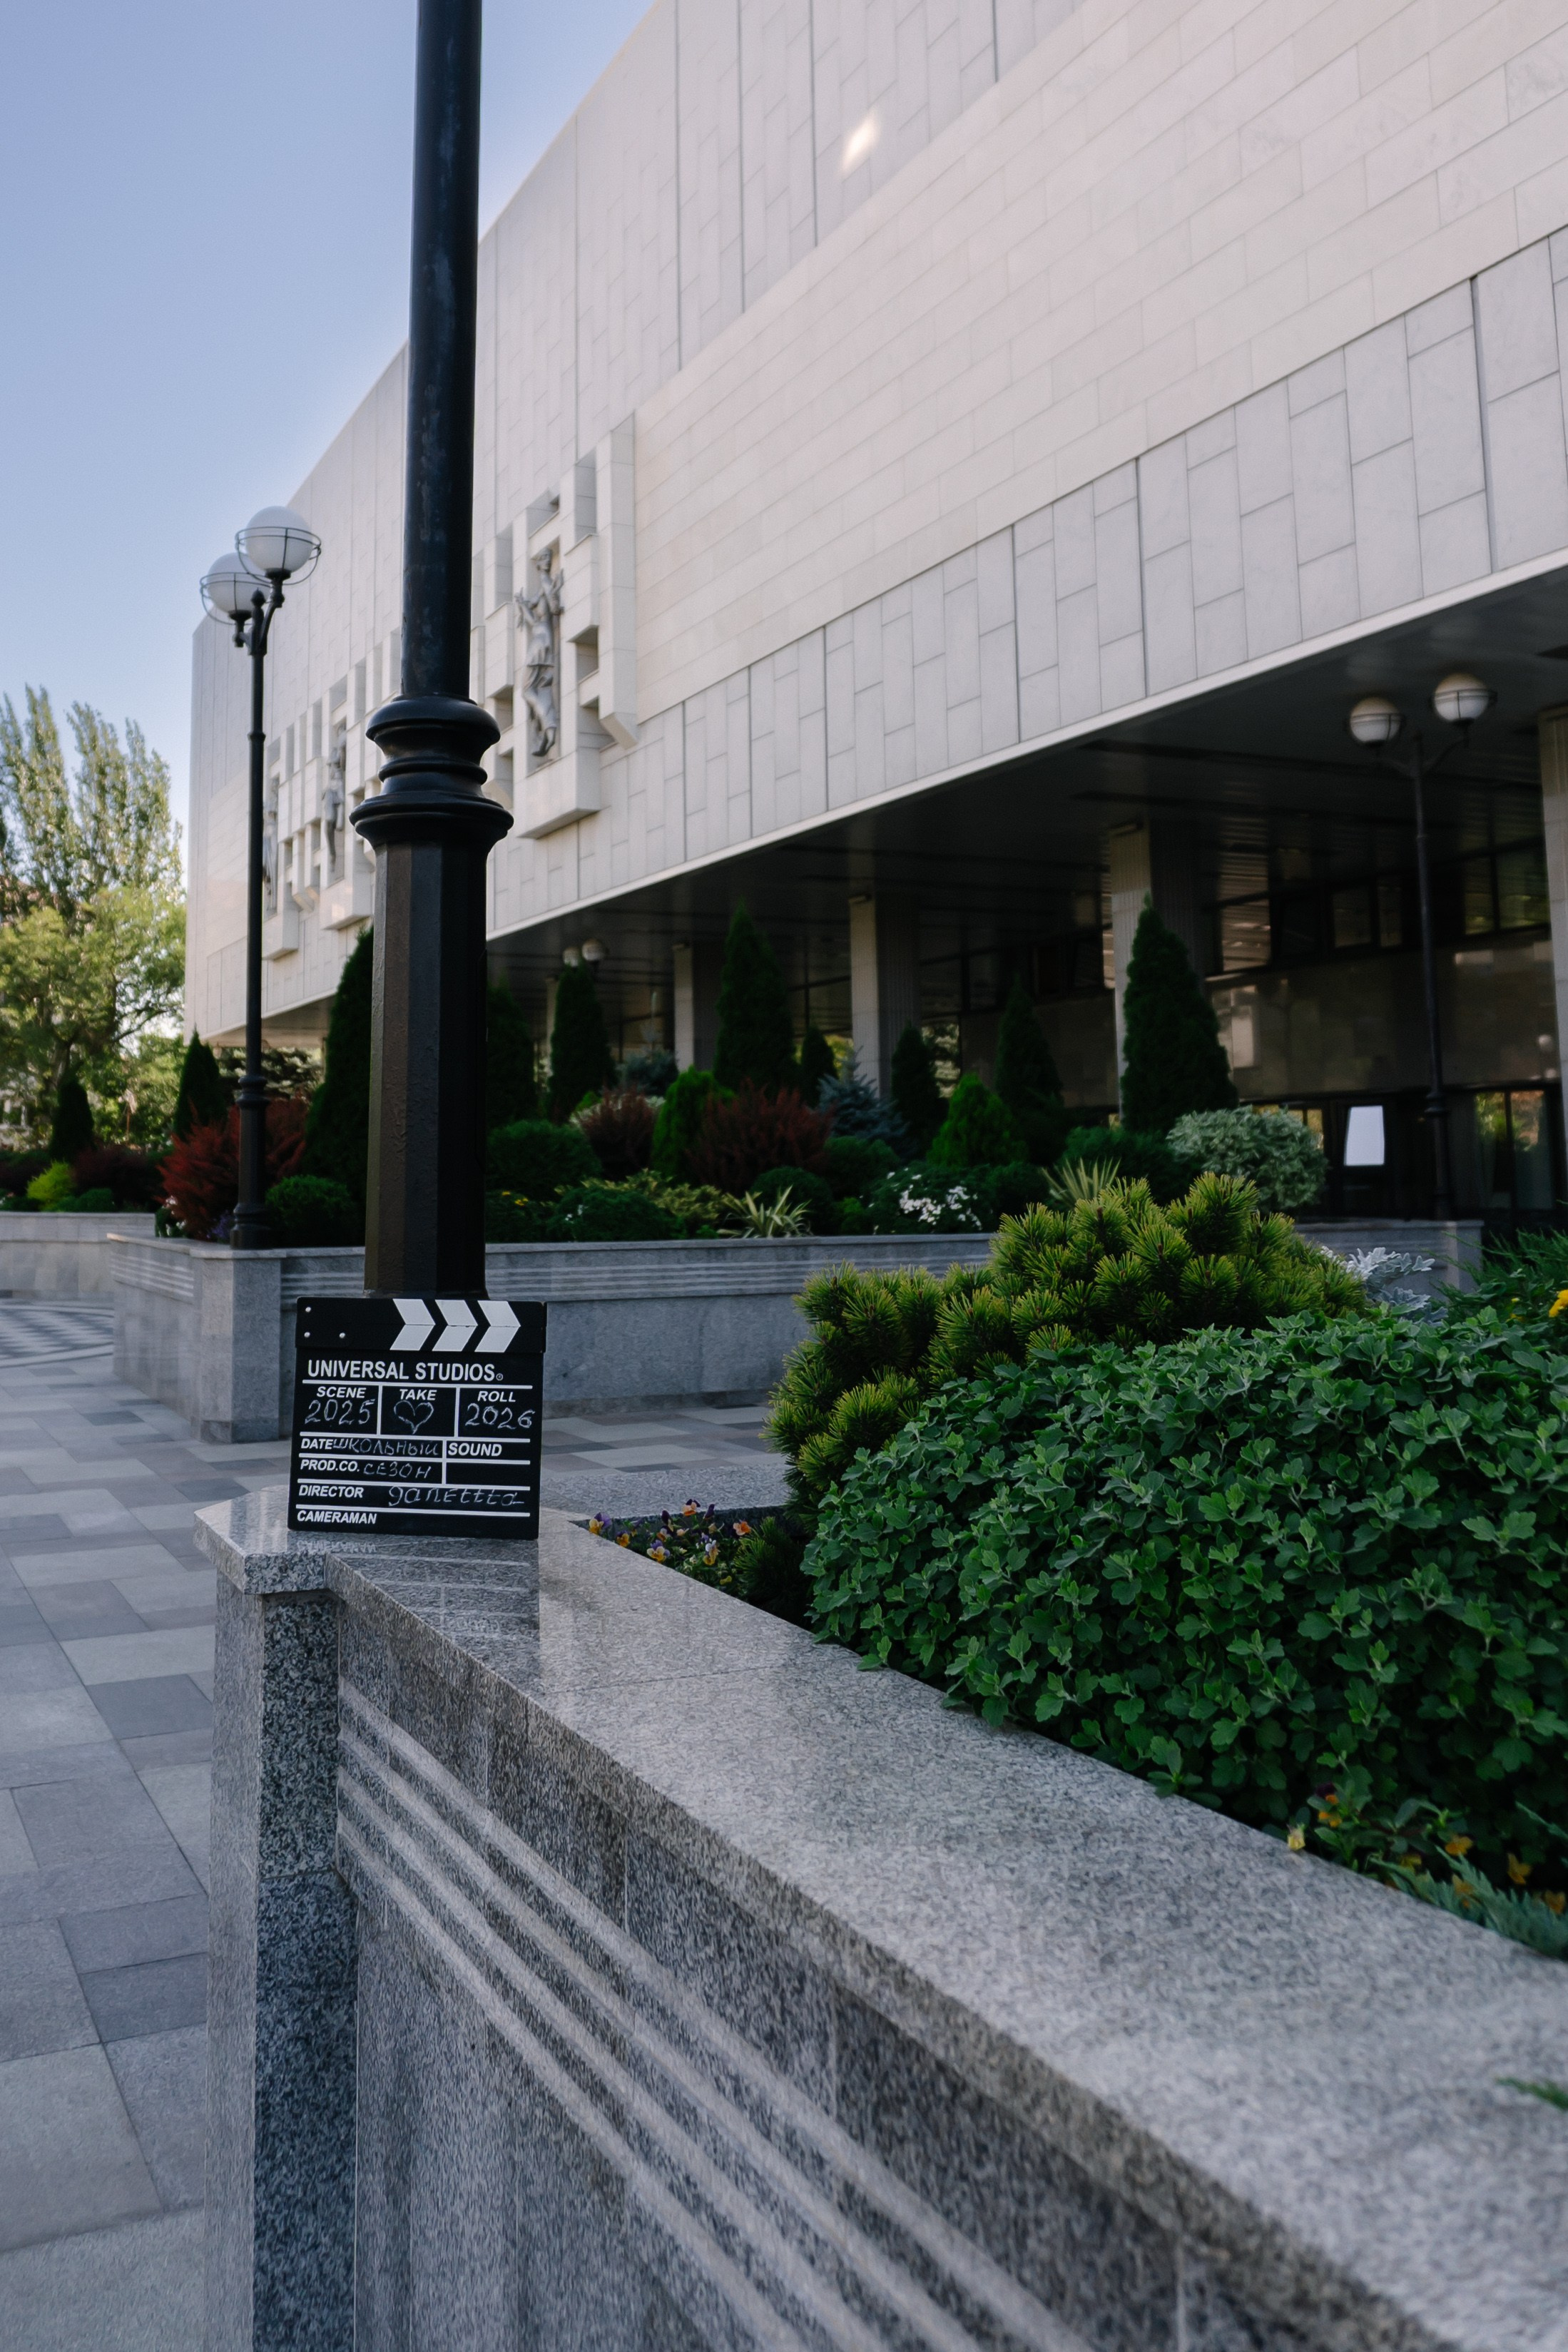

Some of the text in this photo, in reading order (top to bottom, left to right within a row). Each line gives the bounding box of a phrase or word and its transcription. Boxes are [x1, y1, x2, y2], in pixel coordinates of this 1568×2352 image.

[307, 1359, 409, 1380] UNIVERSAL
[316, 1386, 367, 1398] SCENE
[399, 1388, 437, 1400] TAKE
[477, 1390, 516, 1402] ROLL
[305, 1398, 376, 1425] 2025
[465, 1402, 536, 1430] 2026
[300, 1437, 333, 1450] DATE
[447, 1442, 502, 1457] SOUND
[300, 1459, 360, 1472] PROD.CO.
[362, 1461, 432, 1479] СЕЗОН
[298, 1485, 365, 1498] DIRECTOR
[297, 1510, 377, 1524] CAMERAMAN
